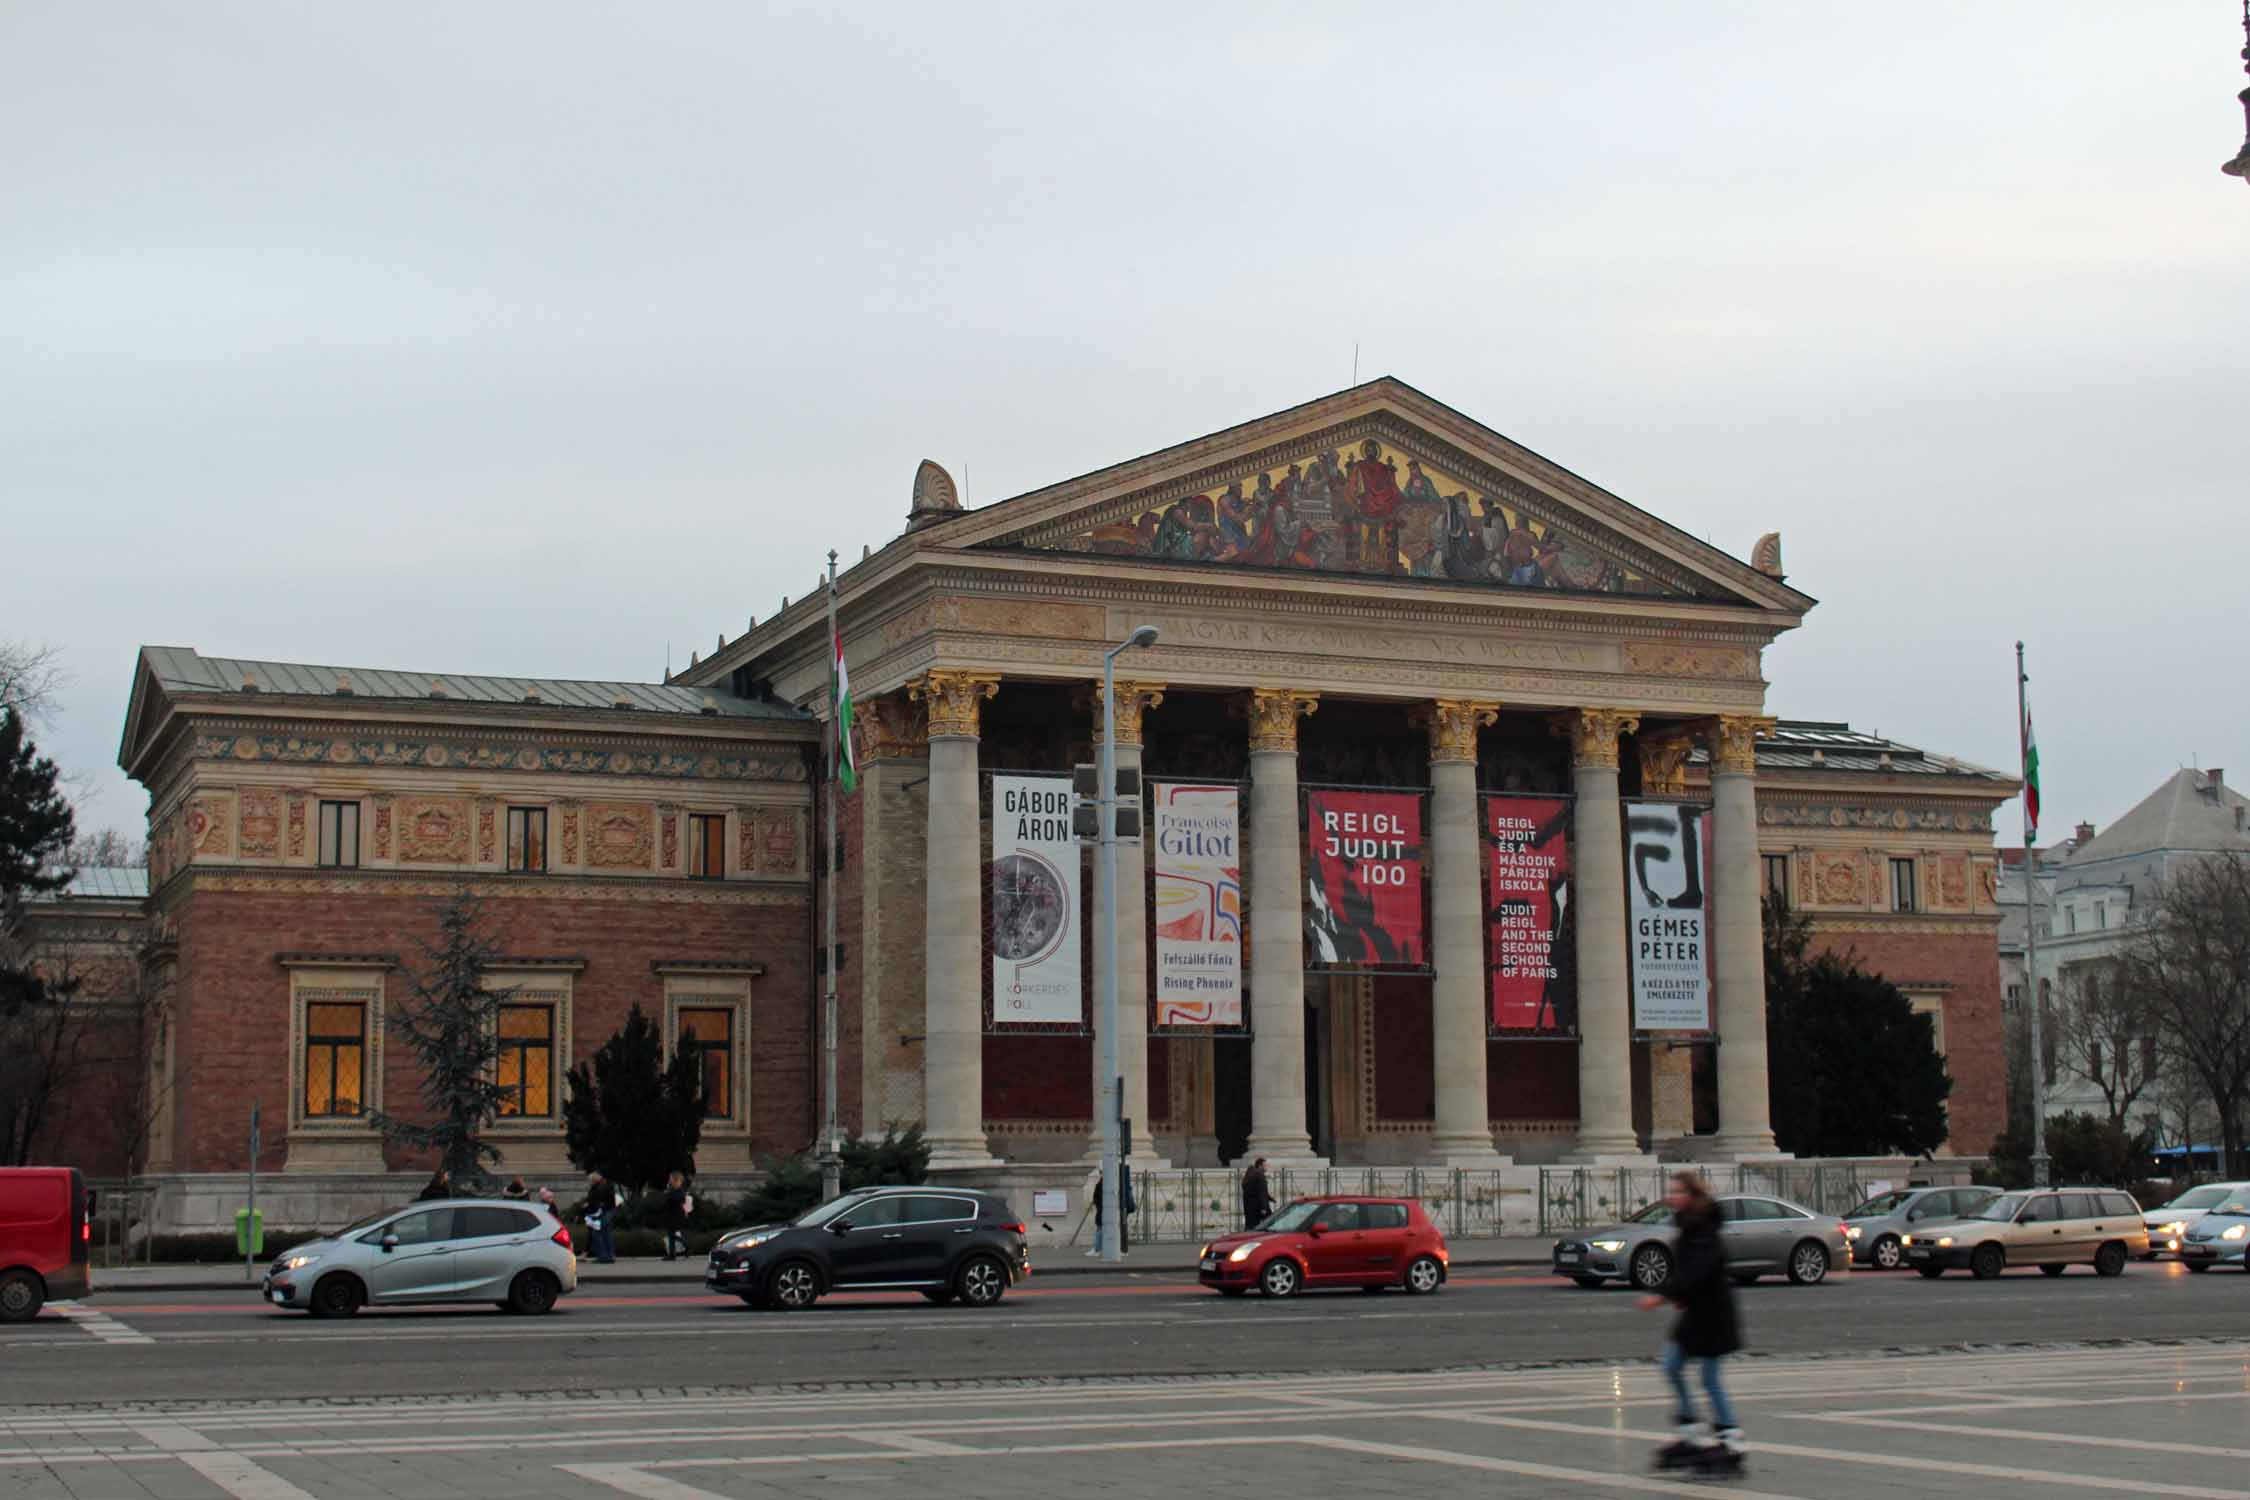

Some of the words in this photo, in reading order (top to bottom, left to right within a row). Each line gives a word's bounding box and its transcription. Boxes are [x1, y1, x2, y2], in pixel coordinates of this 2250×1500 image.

[1006, 786, 1068, 815] GÁBOR
[1016, 814, 1068, 842] ÁRON
[1324, 811, 1405, 834] REIGL
[1498, 817, 1536, 829] REIGL
[1498, 829, 1536, 841] JUDIT
[1160, 829, 1233, 858] Gilot
[1325, 837, 1405, 860] JUDIT
[1498, 840, 1514, 853] ÉS
[1519, 843, 1526, 853] A
[1499, 853, 1556, 867] MÁSODIK
[1362, 864, 1405, 886] 100
[1499, 865, 1549, 879] PÁRIZSI
[1499, 879, 1545, 892] ISKOLA
[1501, 905, 1536, 916] JUDIT
[1501, 917, 1536, 928] REIGL
[1639, 914, 1698, 937] GÉMES
[1501, 930, 1526, 941] AND
[1530, 930, 1553, 941] THE
[1502, 942, 1551, 953] SECOND
[1640, 937, 1698, 960] PÉTER
[1502, 955, 1551, 966] SCHOOL
[1502, 967, 1519, 978] OF
[1522, 967, 1558, 979] PARIS
[1164, 976, 1194, 991] Rising
[1197, 976, 1233, 990] Phoenix
[1681, 979, 1700, 990] TEST
